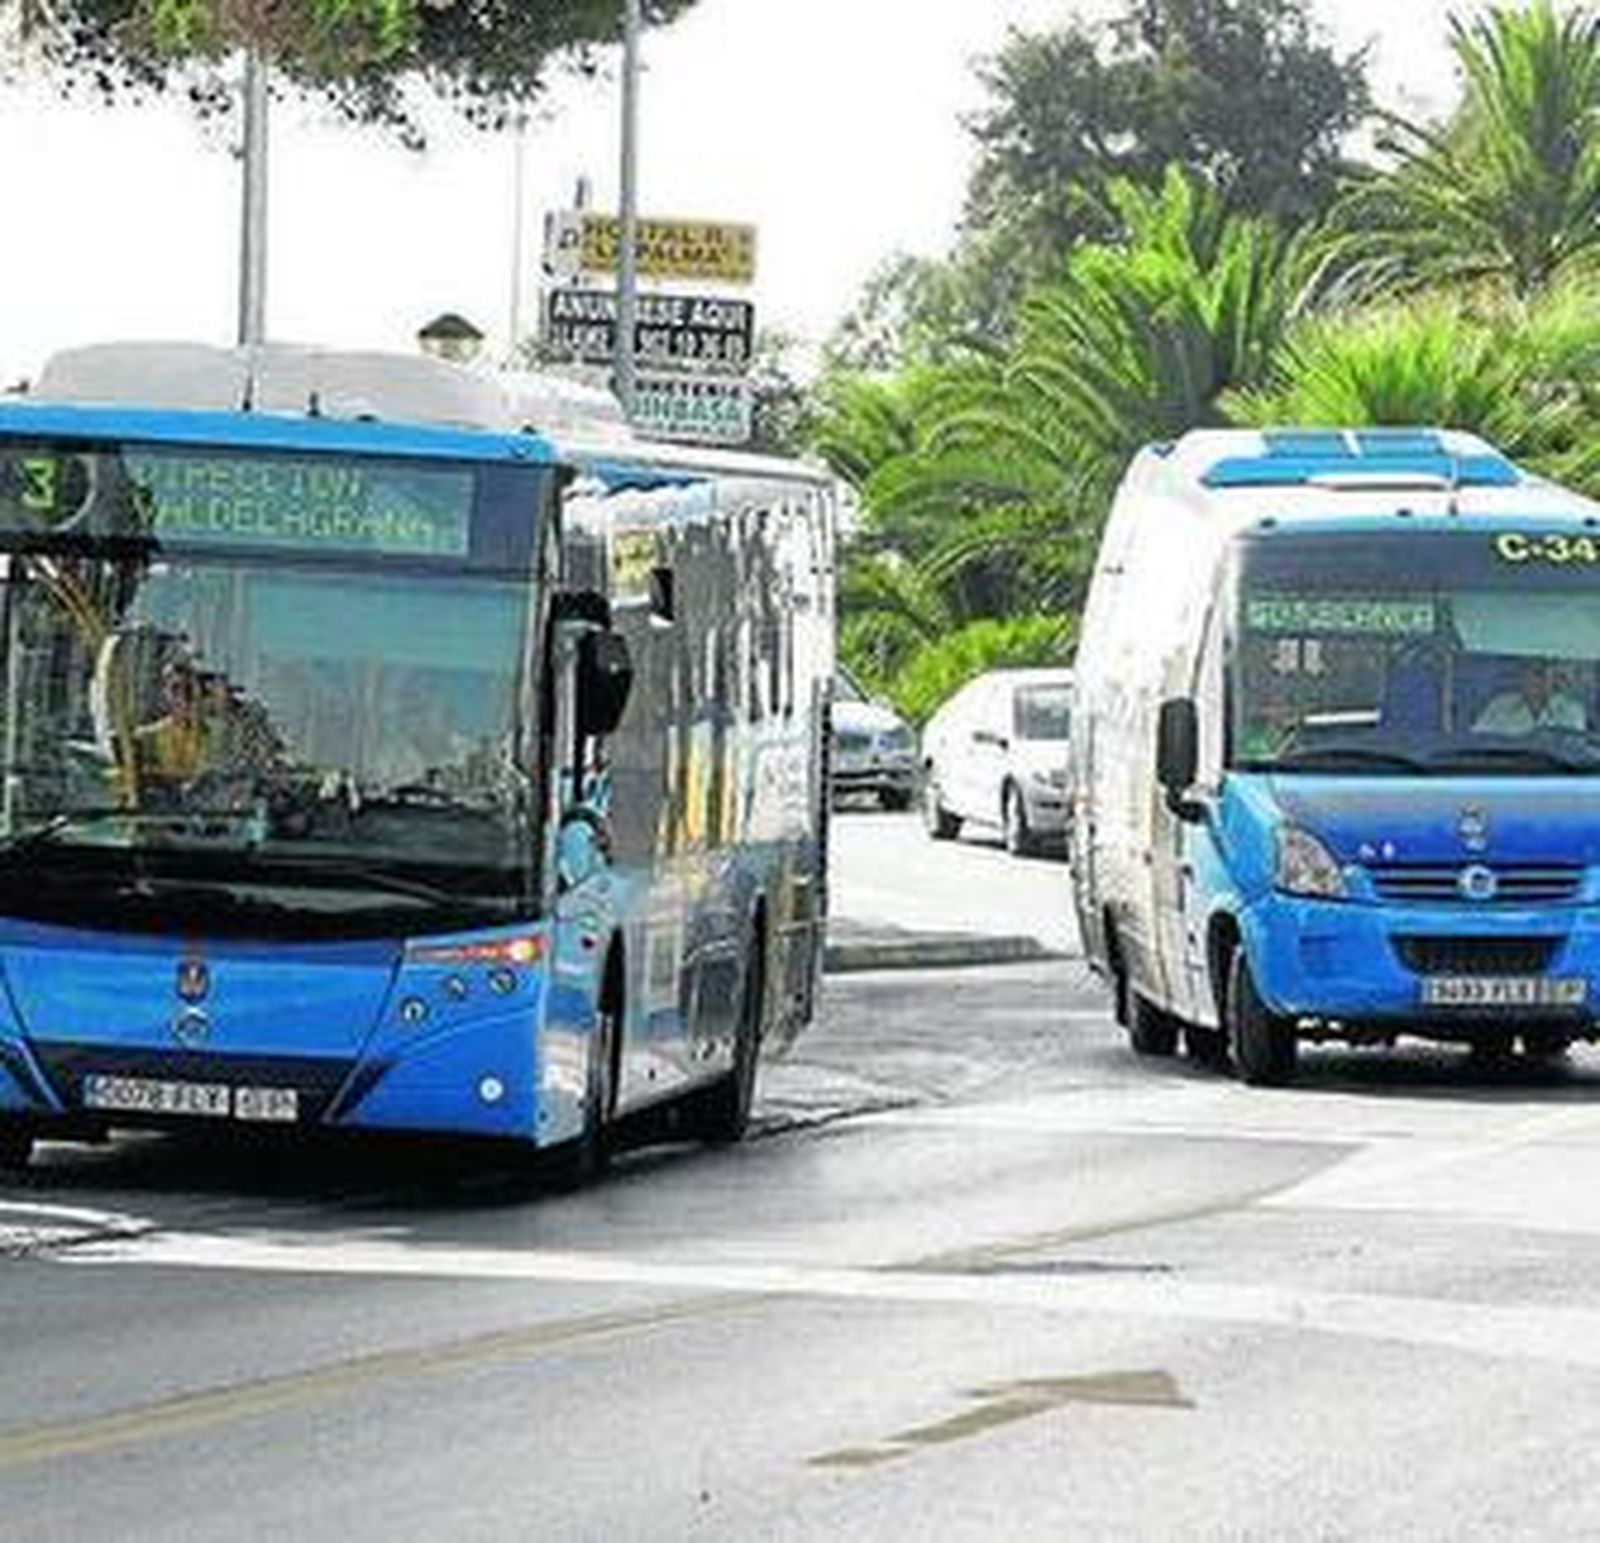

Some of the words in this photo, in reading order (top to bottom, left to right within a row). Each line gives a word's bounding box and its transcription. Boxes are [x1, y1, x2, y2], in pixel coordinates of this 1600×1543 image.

[584, 217, 697, 244] HOTAL
[553, 294, 685, 326] ANUNIESE
[19, 457, 56, 509] 3
